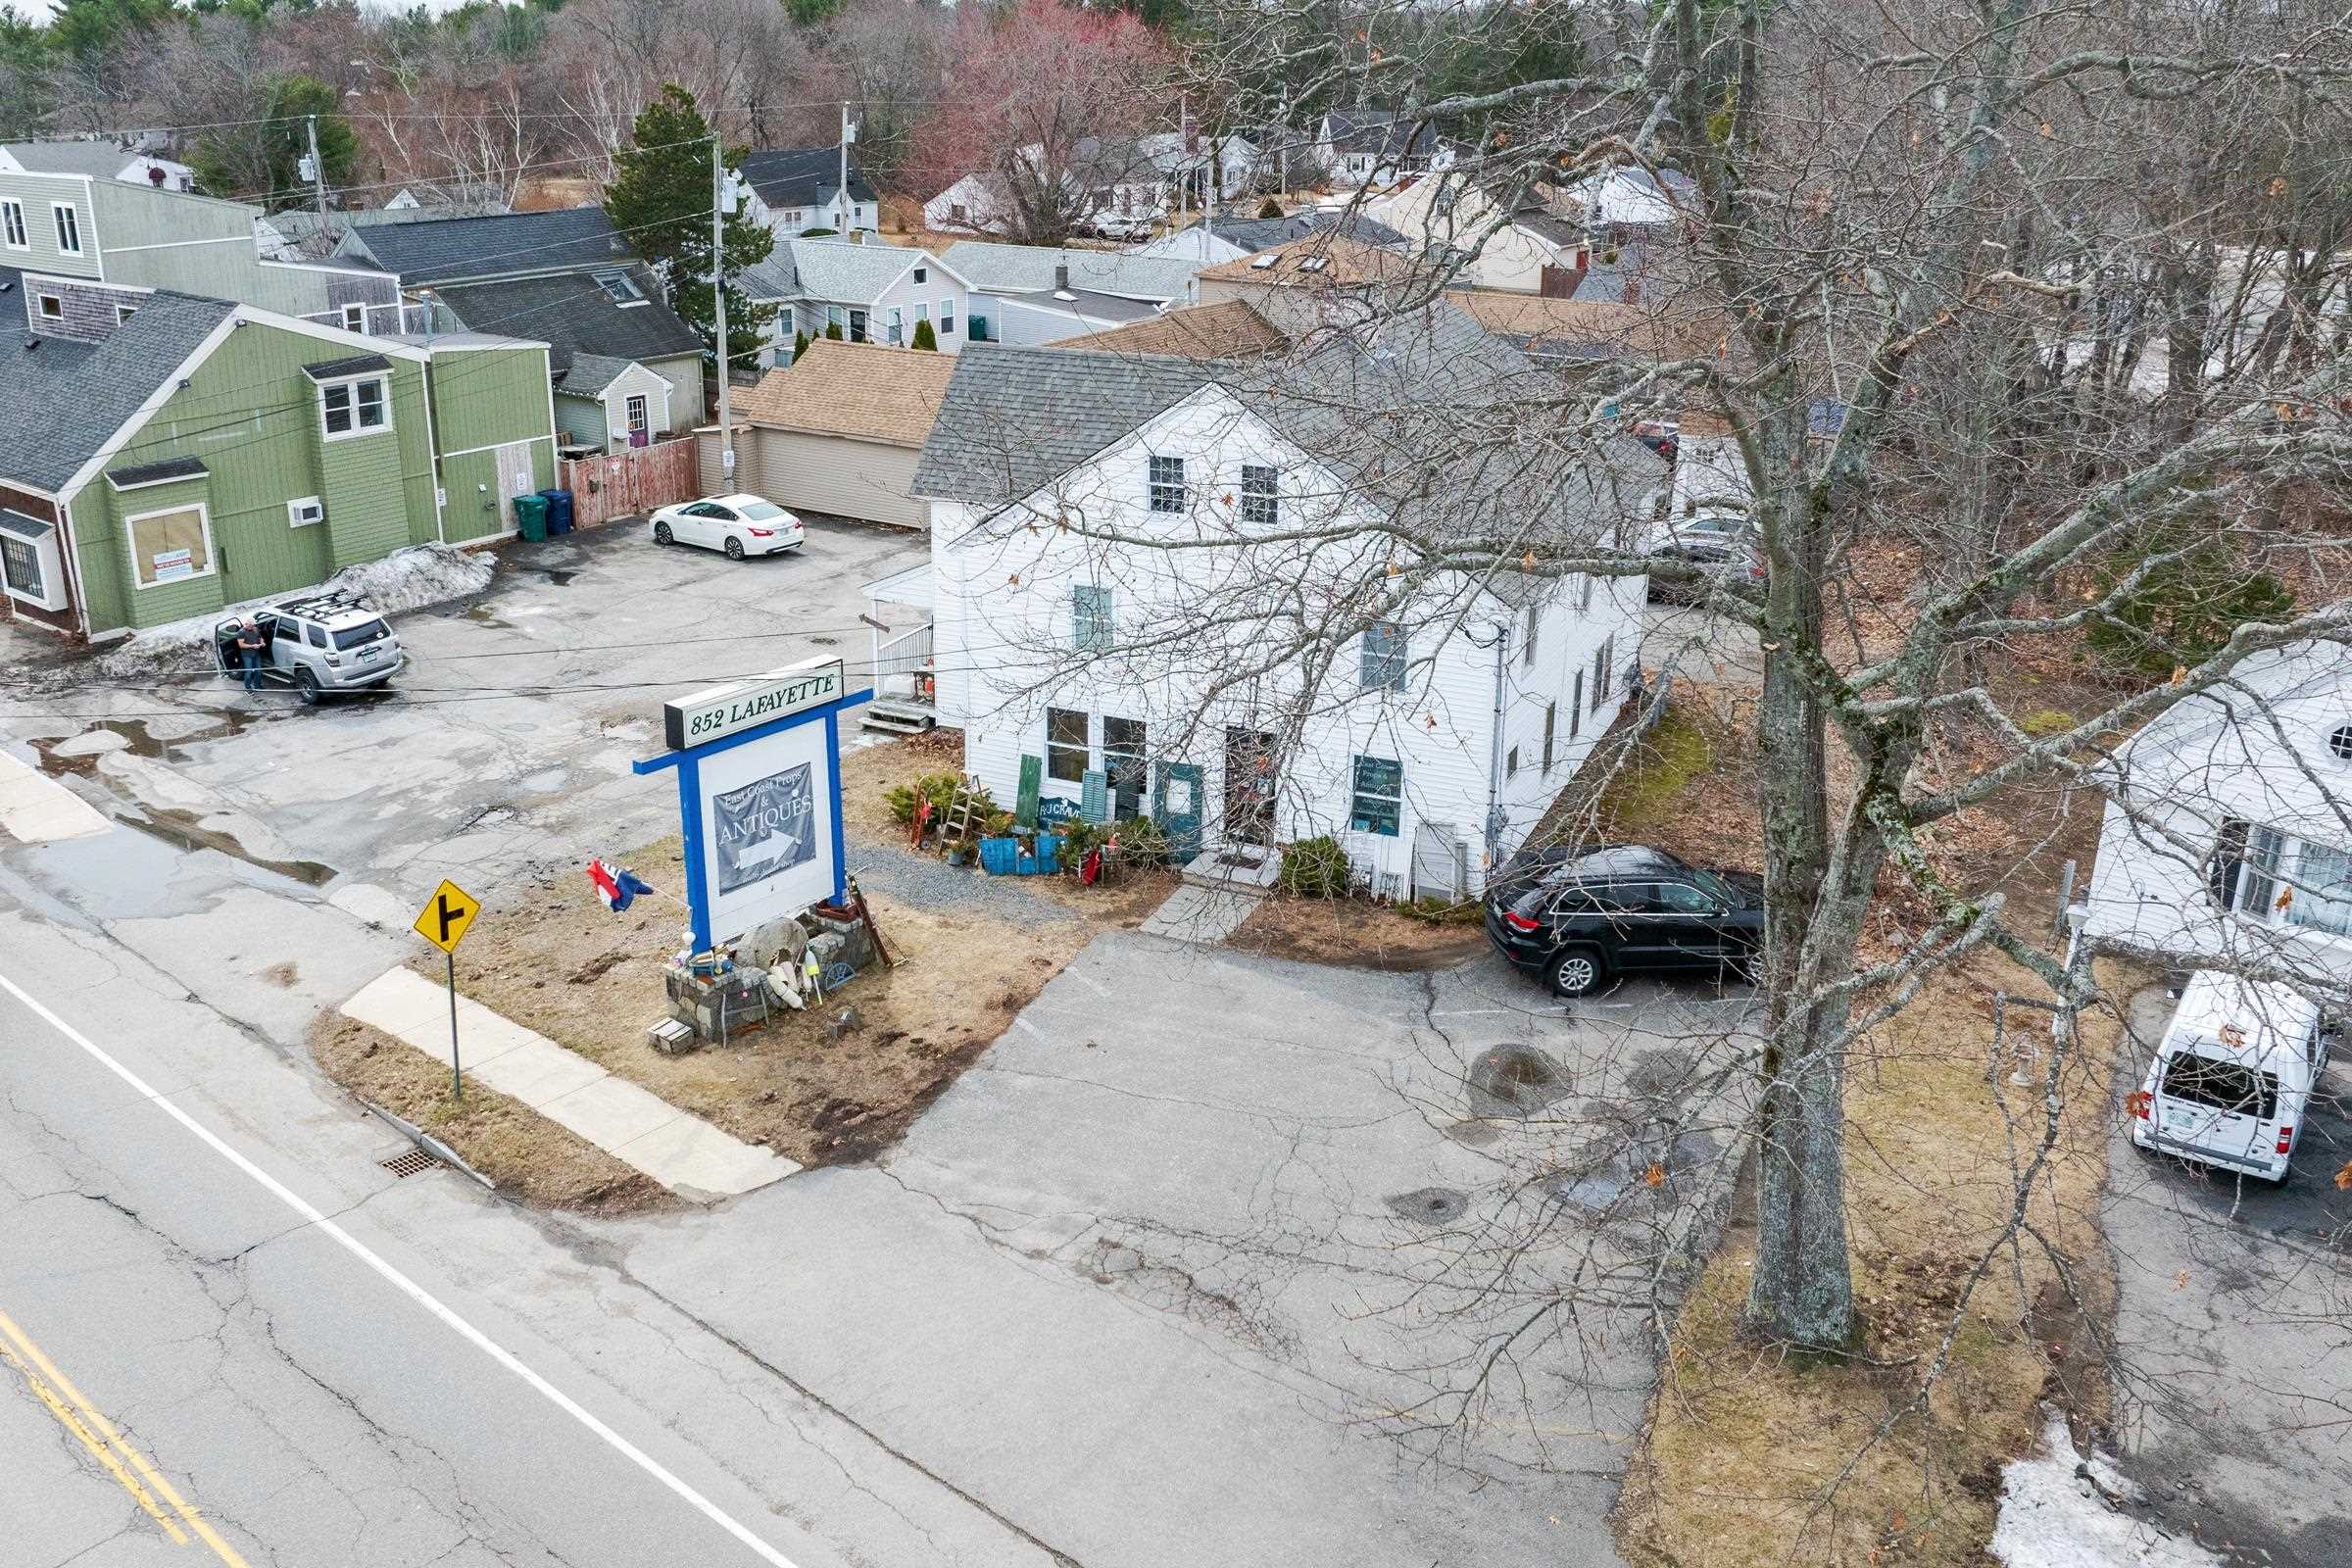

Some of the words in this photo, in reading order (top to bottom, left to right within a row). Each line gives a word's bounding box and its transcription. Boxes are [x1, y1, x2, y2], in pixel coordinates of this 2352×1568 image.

[691, 709, 724, 735] 852
[729, 673, 834, 723] LAFAYETTE
[718, 794, 811, 845] ANTIQUES
[760, 796, 769, 807] &
